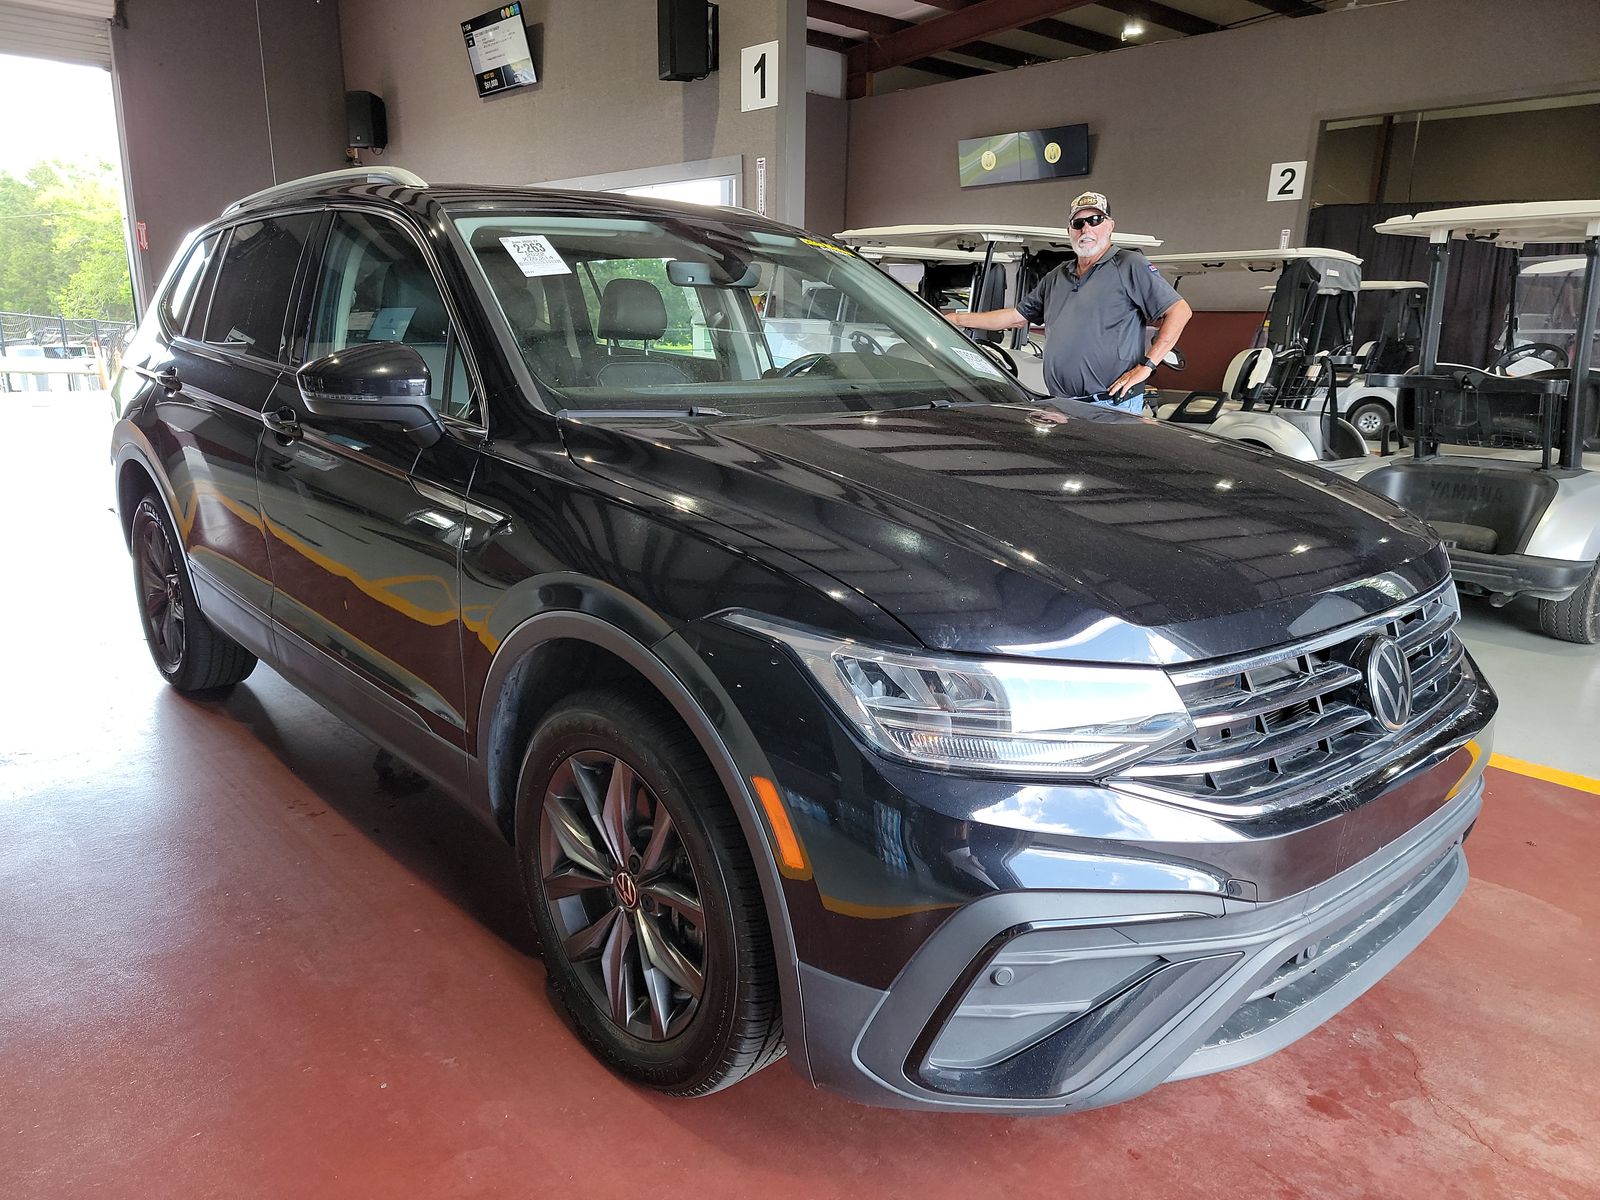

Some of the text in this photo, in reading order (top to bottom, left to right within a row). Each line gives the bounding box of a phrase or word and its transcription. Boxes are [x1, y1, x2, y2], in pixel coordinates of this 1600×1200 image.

[753, 52, 767, 99] 1
[1277, 168, 1296, 195] 2
[1431, 480, 1503, 502] YAMAHA
